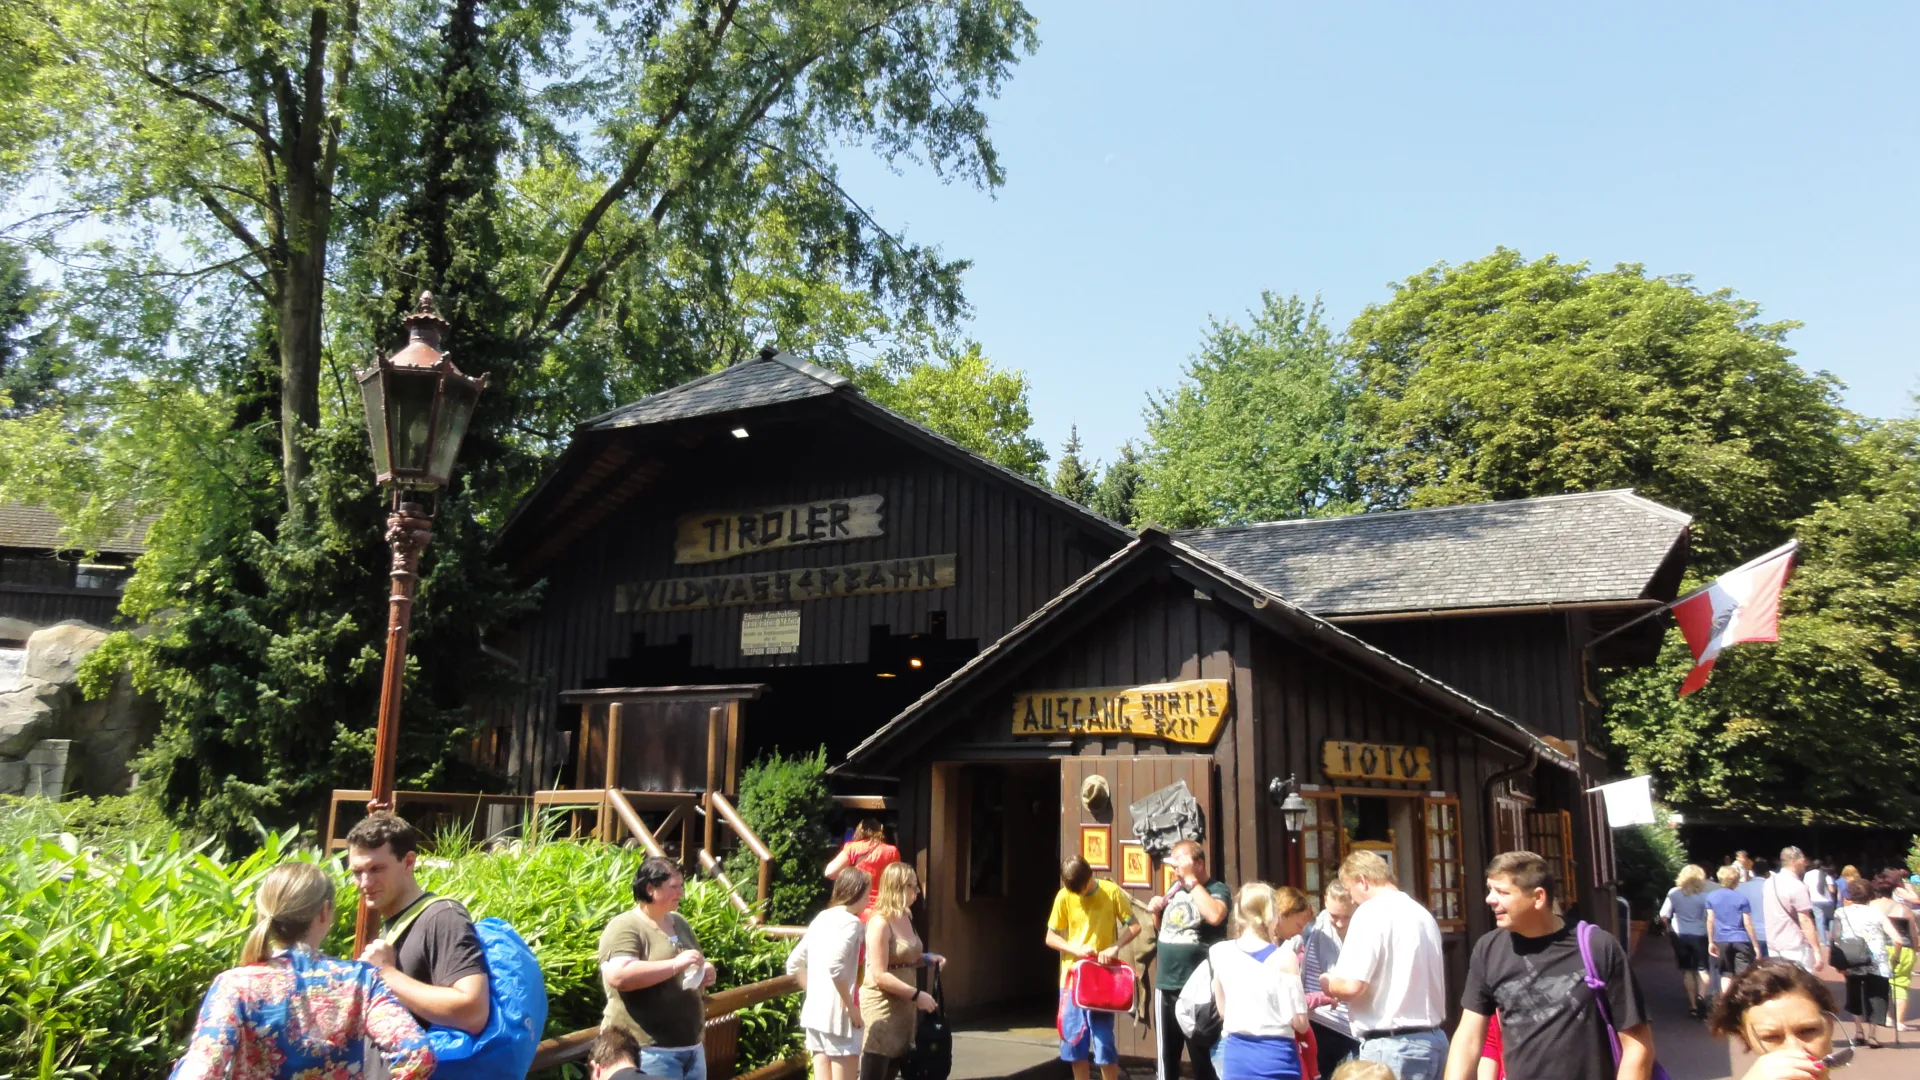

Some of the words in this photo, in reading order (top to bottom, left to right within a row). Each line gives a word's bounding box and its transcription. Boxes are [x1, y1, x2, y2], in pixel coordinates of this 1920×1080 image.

[702, 502, 850, 552] TIROLER
[624, 559, 937, 608] WILDWASSERBAHN
[1023, 695, 1132, 731] AUSGANG
[1141, 687, 1219, 720] SORTIE
[1154, 716, 1199, 740] EXIT
